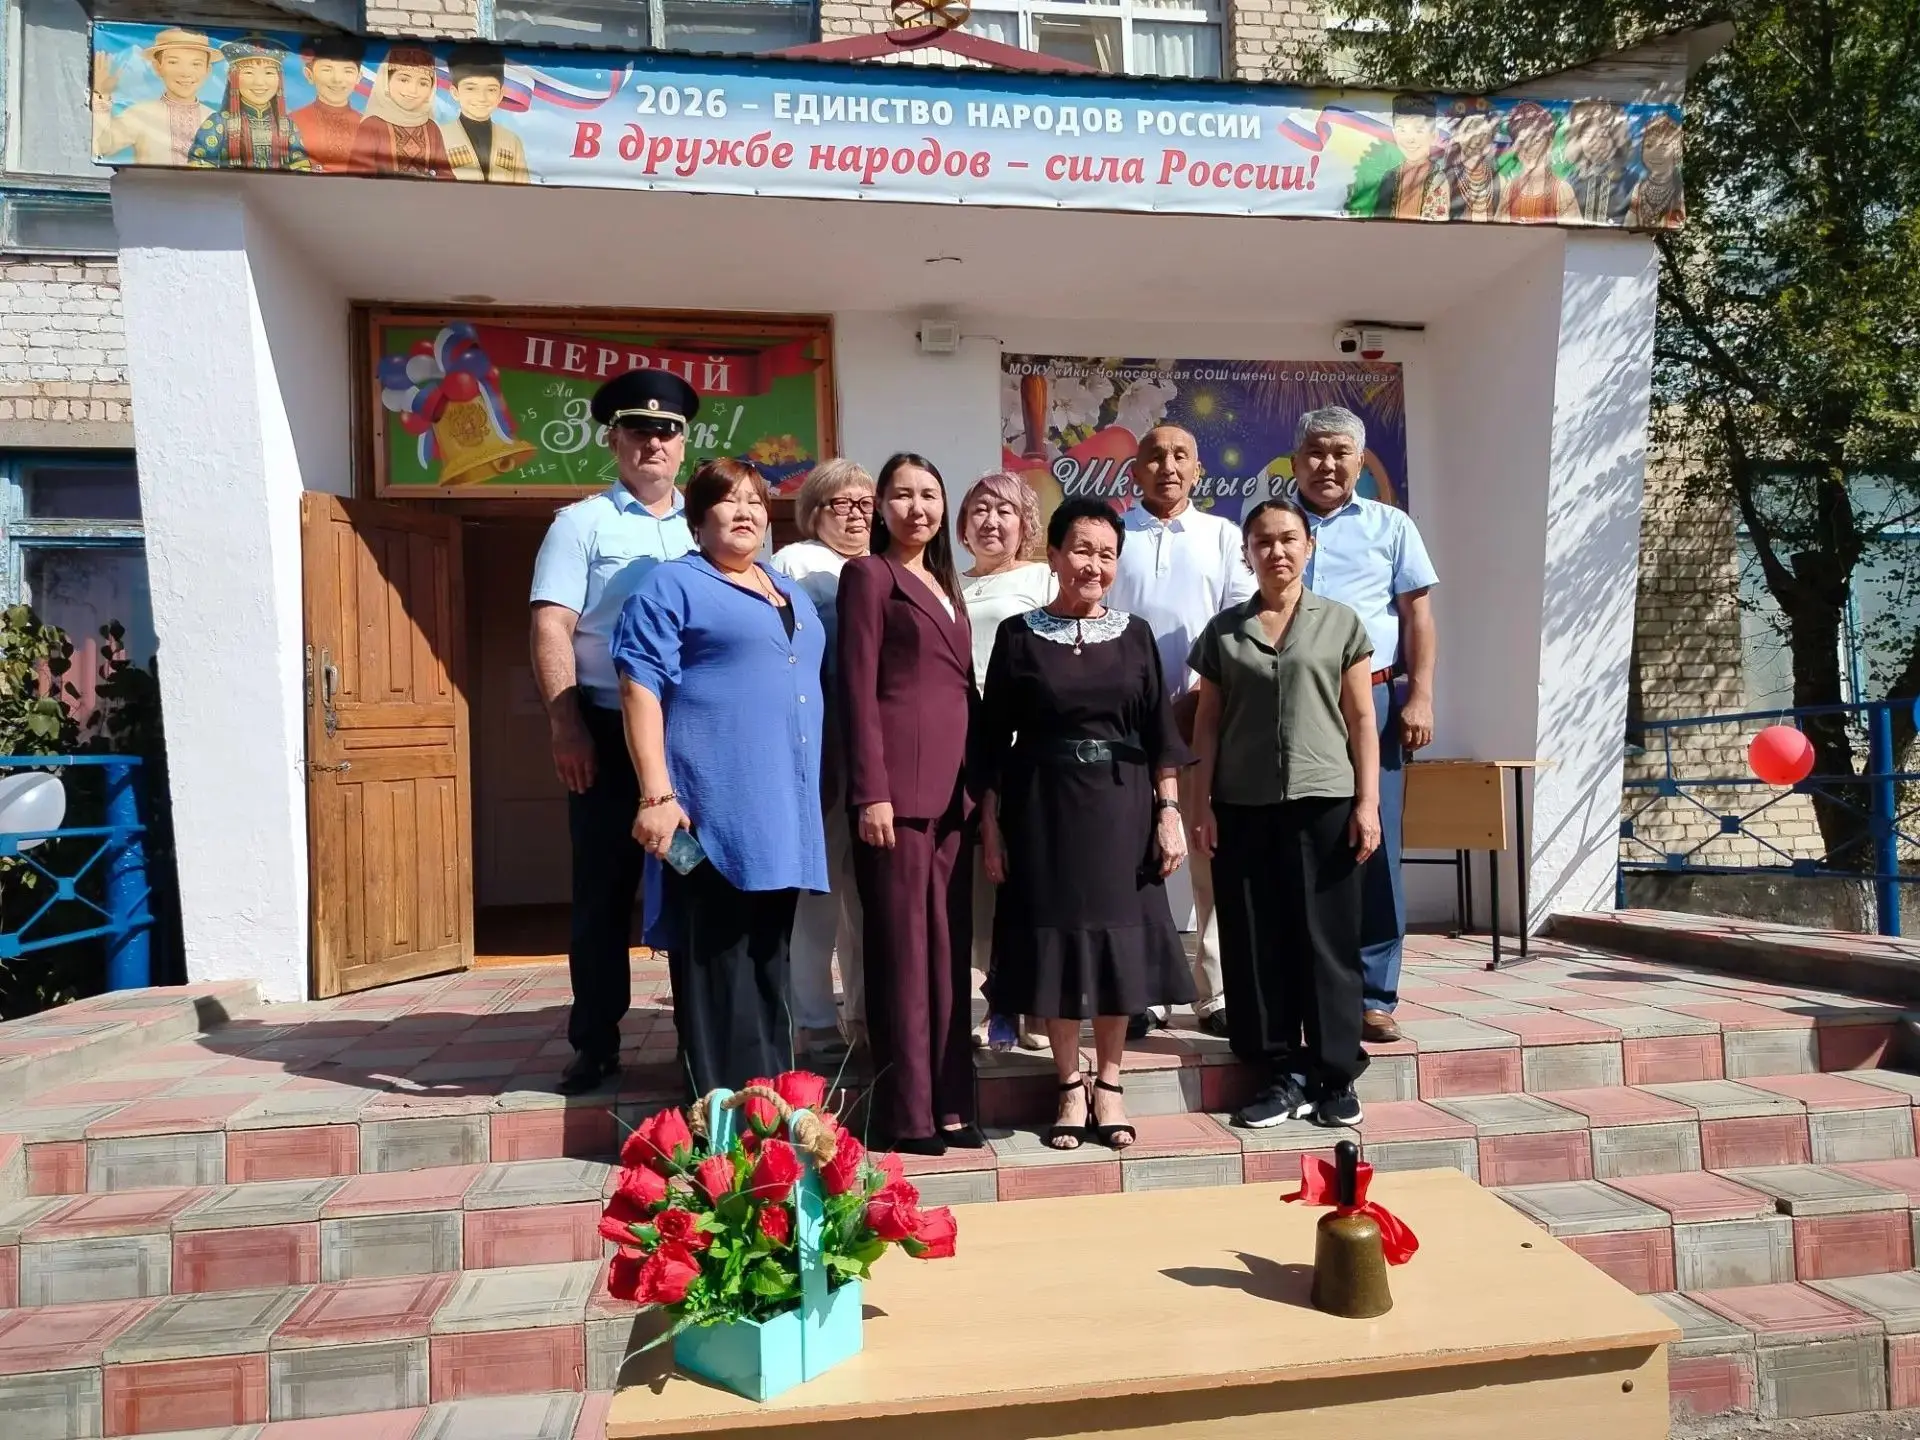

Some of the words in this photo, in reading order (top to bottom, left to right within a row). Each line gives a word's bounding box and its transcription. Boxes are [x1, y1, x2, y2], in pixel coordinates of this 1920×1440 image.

[636, 84, 728, 118] 2026
[774, 92, 953, 126] ЕДИНСТВО
[967, 102, 1123, 137] НАРОДОВ
[1137, 110, 1262, 140] РОССИИ
[569, 121, 602, 160] В
[618, 123, 794, 178] дружбе
[809, 137, 991, 185] народов
[1045, 154, 1145, 184] сила
[1156, 149, 1321, 191] России!
[1009, 363, 1051, 376] МОКУ
[1194, 369, 1228, 381] СОШ
[1232, 371, 1276, 382] имени
[1053, 457, 1257, 497] Шкные
